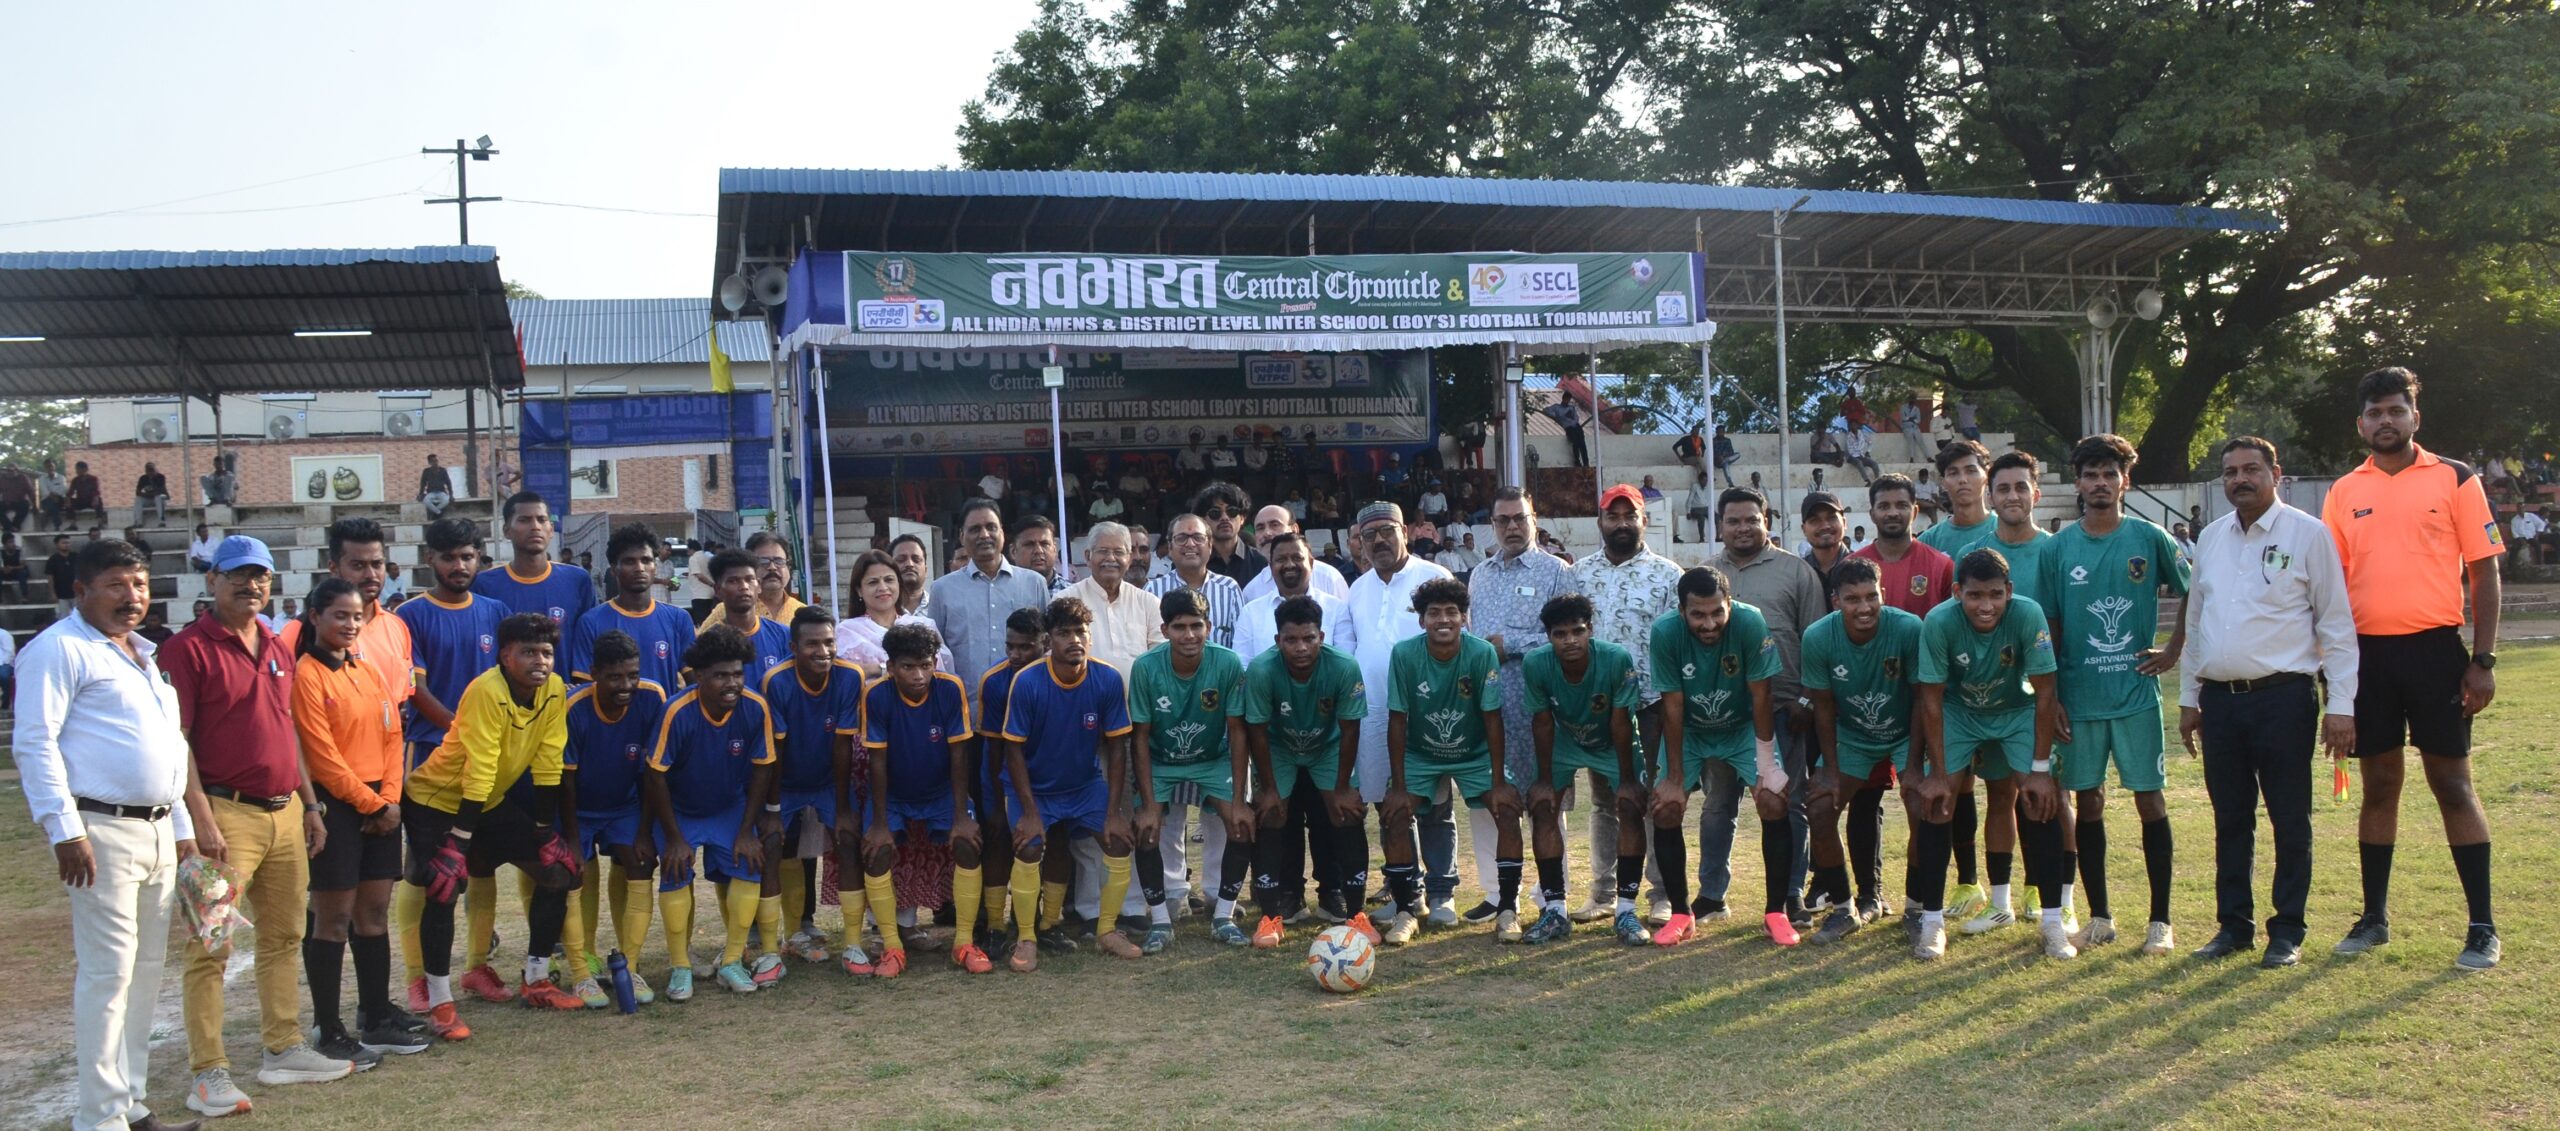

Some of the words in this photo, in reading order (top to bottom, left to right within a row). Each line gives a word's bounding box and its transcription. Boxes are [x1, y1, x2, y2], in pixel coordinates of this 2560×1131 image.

[888, 263, 904, 281] 17
[1532, 271, 1577, 291] SECL
[986, 256, 1220, 310] नवभारत
[1223, 270, 1321, 300] Central
[1324, 269, 1442, 305] Chronicle
[1446, 278, 1465, 301] &
[869, 317, 902, 325] NTPC
[951, 316, 984, 332] ALL
[987, 316, 1041, 332] INDIA
[1045, 316, 1098, 332] MENS
[1102, 318, 1117, 331] &
[1120, 315, 1208, 331] DISTRICT
[1211, 315, 1262, 331] LEVEL
[1264, 315, 1316, 330] INTER
[1319, 314, 1389, 330] SCHOOL
[1392, 313, 1456, 329] (BOY'S)
[1459, 312, 1541, 329] FOOTBALL
[1543, 310, 1653, 327] TOURNAMENT
[989, 371, 1045, 391] Centra
[1064, 370, 1126, 392] hronicle
[1256, 373, 1290, 382] NTPC
[867, 405, 893, 424] ALL
[894, 404, 937, 424] INDIA
[937, 403, 980, 423] MENS
[982, 405, 994, 422] &
[1066, 400, 1106, 420] LEVEL
[1108, 400, 1150, 419] INTER
[1151, 399, 1207, 418] SCHOOL
[1262, 397, 1328, 416] FOOTBALL
[1331, 396, 1418, 415] TOURNAMENT
[2084, 654, 2139, 665] ASHTVINAYA
[2098, 664, 2128, 673] PHYSIO
